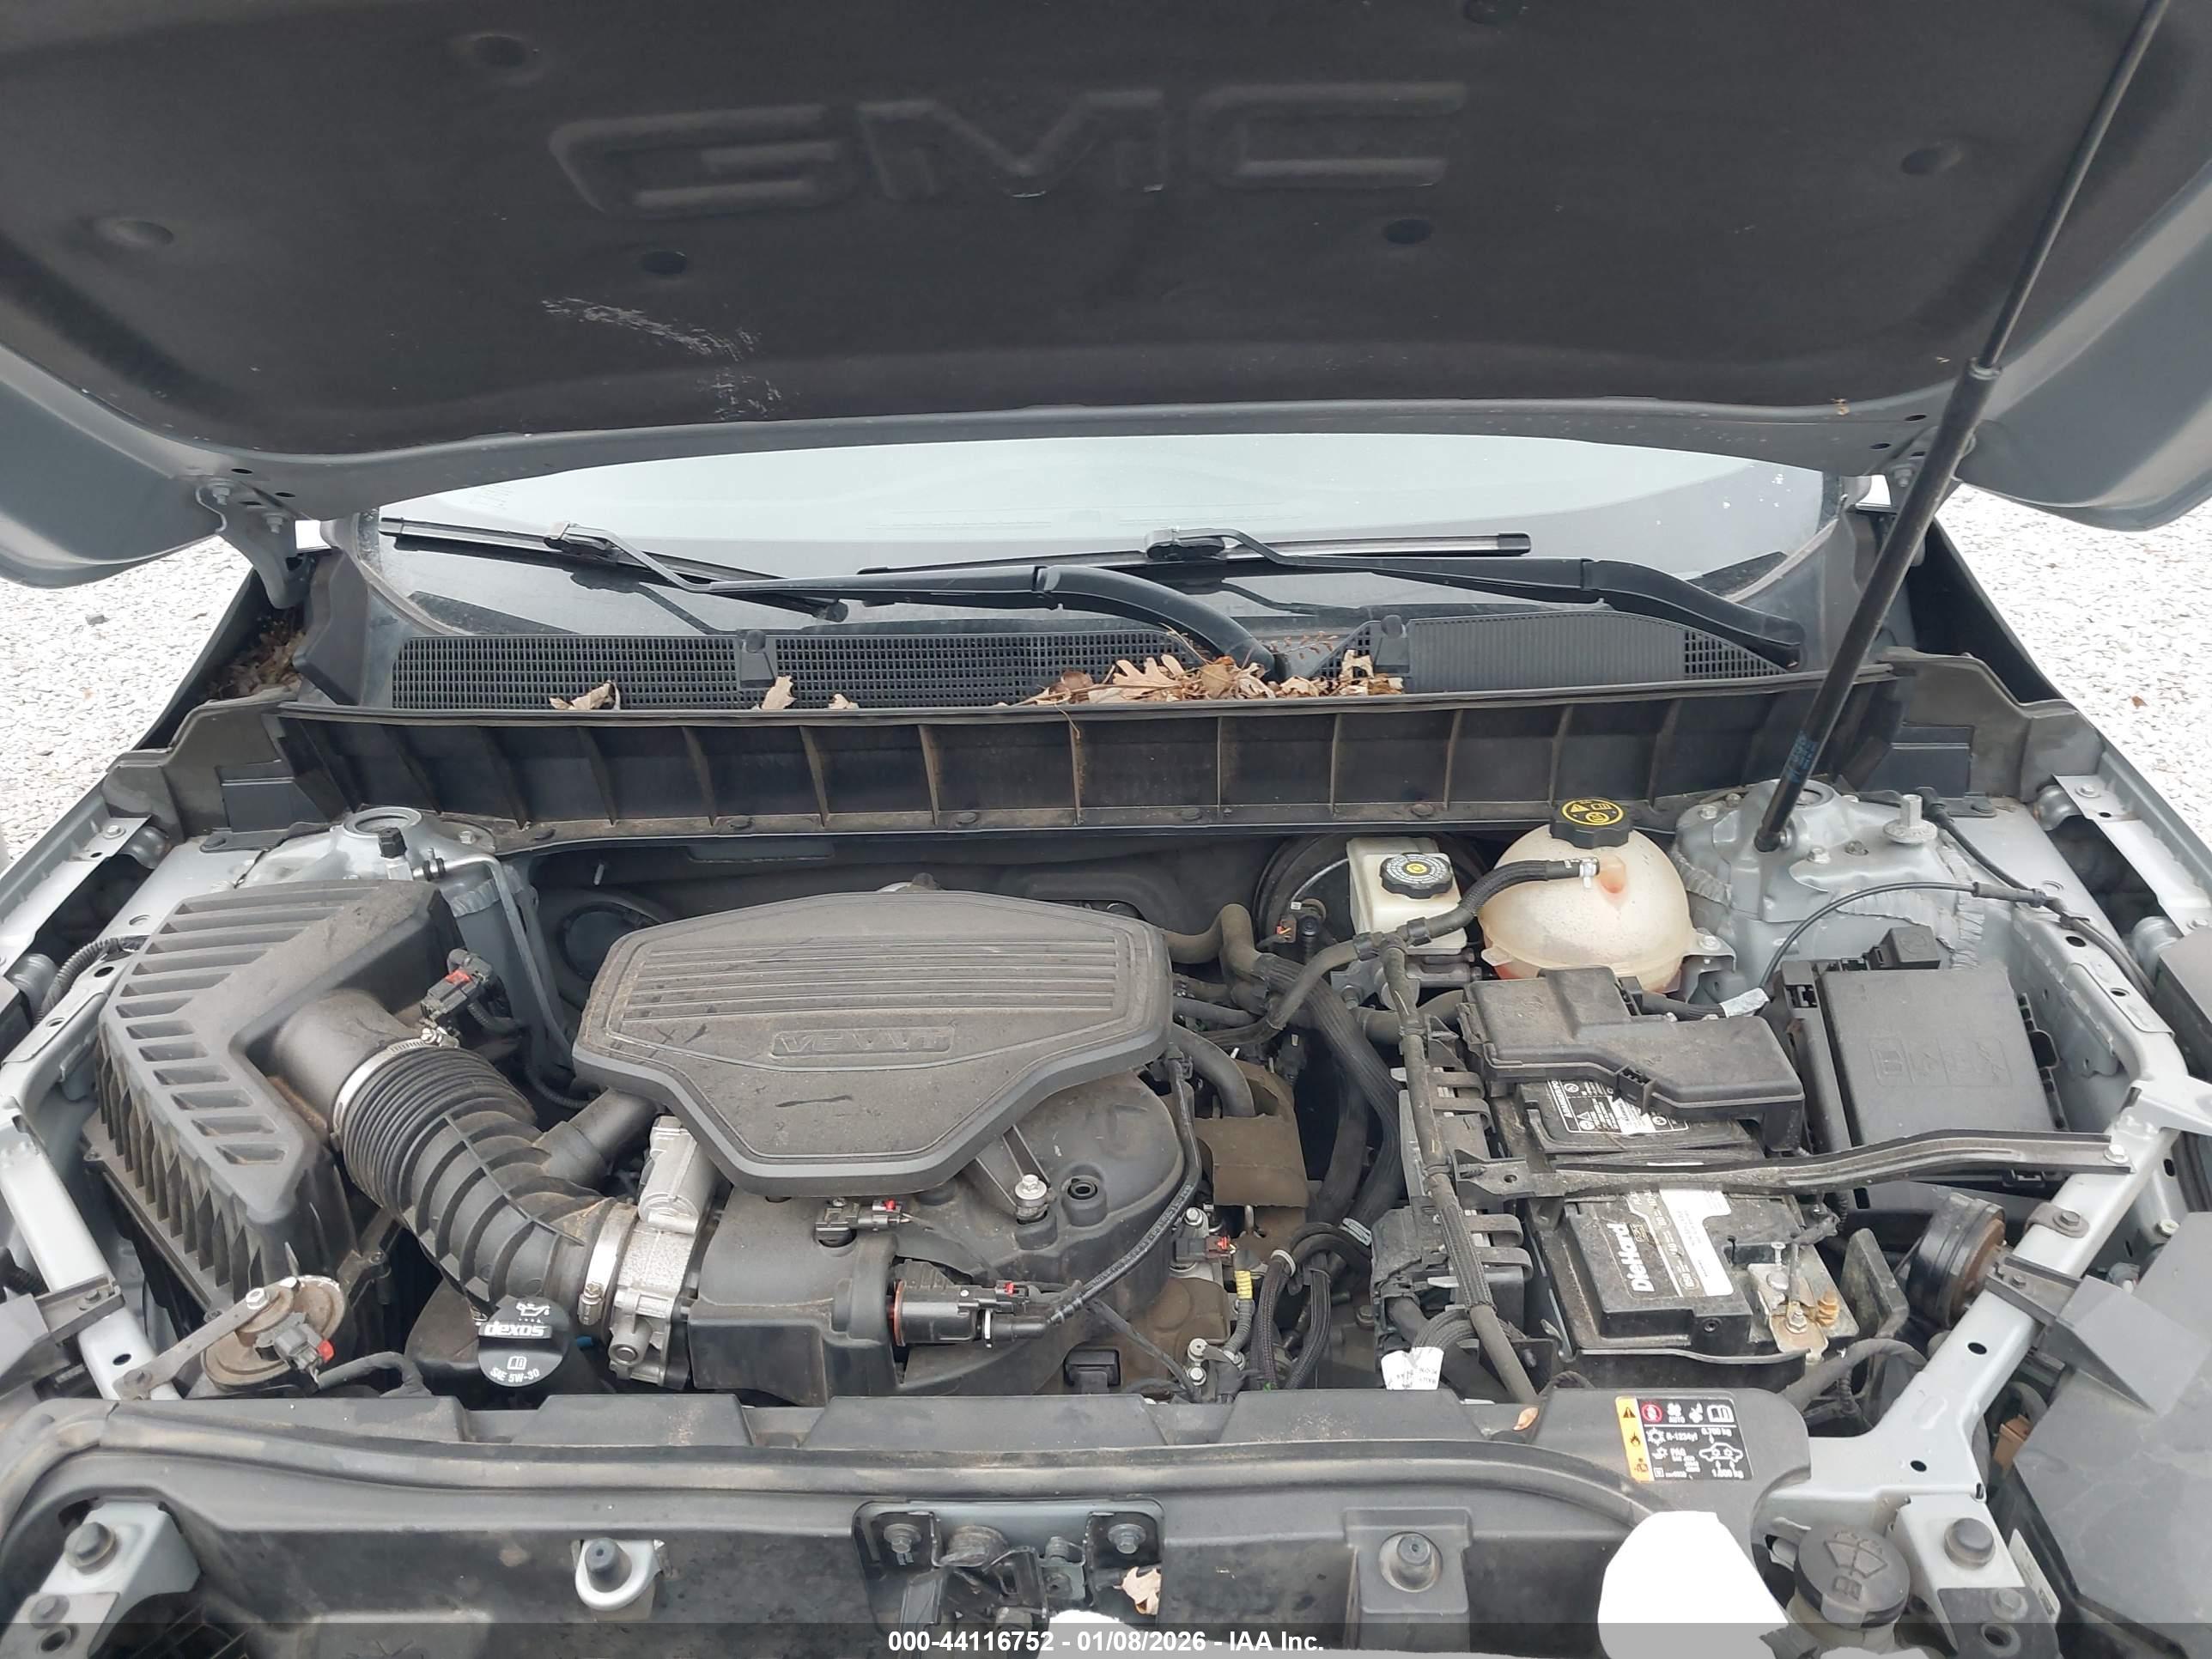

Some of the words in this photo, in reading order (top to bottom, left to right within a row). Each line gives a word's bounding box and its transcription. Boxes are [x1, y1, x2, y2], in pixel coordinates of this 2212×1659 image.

[548, 81, 1467, 216] GMC
[1607, 1223, 1655, 1292] DieHard
[484, 1321, 549, 1337] dexos
[489, 1367, 507, 1382] SAE
[507, 1368, 540, 1382] 5W-30
